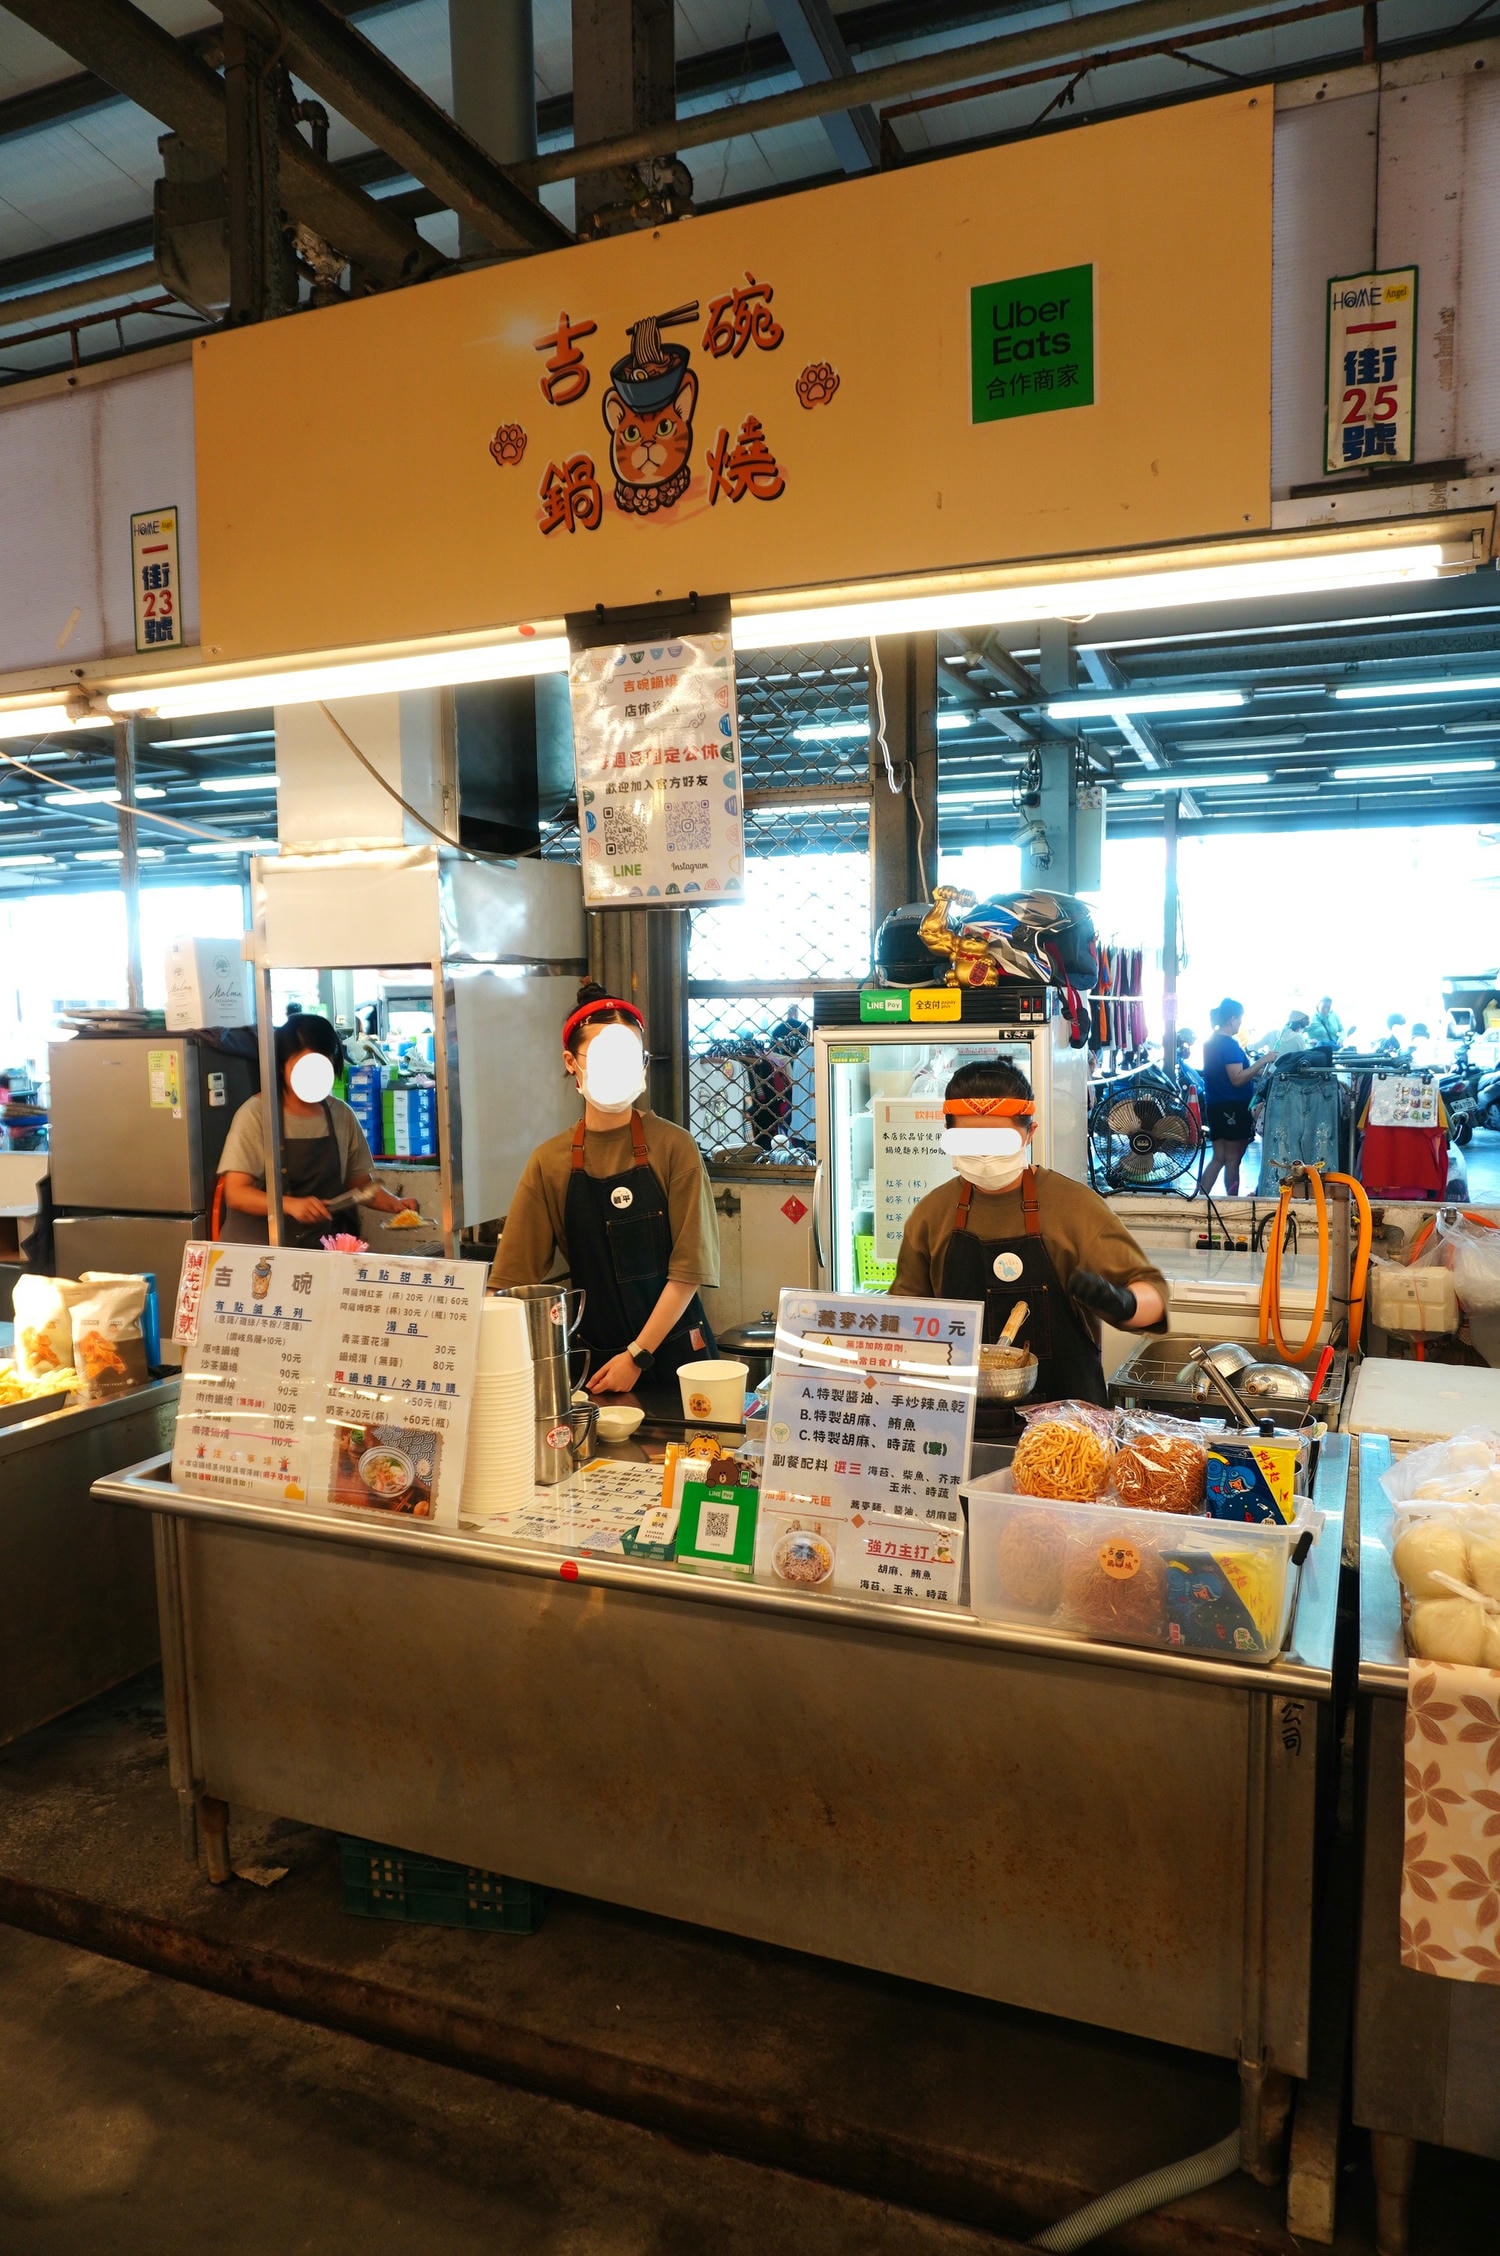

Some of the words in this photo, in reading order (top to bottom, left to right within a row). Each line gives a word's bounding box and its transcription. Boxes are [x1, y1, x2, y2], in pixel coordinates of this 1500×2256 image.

[1333, 287, 1381, 311] HOME
[1386, 286, 1407, 299] Angel
[991, 297, 1070, 332] Uber
[534, 312, 597, 406] 吉
[702, 271, 784, 358] 碗
[992, 330, 1071, 366] Eats
[986, 363, 1080, 401] 合作商家
[538, 454, 603, 535] 鍋
[706, 415, 785, 505] 燒
[605, 774, 708, 795] 歡迎加入官方好友
[618, 826, 633, 834] LINE
[613, 864, 642, 877] LINE
[672, 861, 709, 873] Instagram
[866, 1001, 884, 1009] LINE
[916, 1000, 940, 1010] 全支付
[214, 1266, 234, 1287] 吉
[292, 1272, 313, 1295] 碗
[357, 1269, 455, 1287] 有點甜系列
[450, 1296, 469, 1306] 60元
[449, 1312, 468, 1321] 70元
[817, 1309, 900, 1334] 蕎麥冷麵
[912, 1316, 940, 1338] 70
[948, 1320, 966, 1337] 元
[386, 1320, 418, 1334] 湯品
[281, 1352, 302, 1363] 90元
[435, 1344, 456, 1355] 30元
[280, 1369, 300, 1379] 90元
[432, 1360, 455, 1372] 80元
[273, 1402, 297, 1413] 100元
[273, 1420, 295, 1430] 110元
[772, 1453, 829, 1472] 副餐配料
[867, 1538, 930, 1558] 強力主打
[1281, 1702, 1304, 1757] 公司
